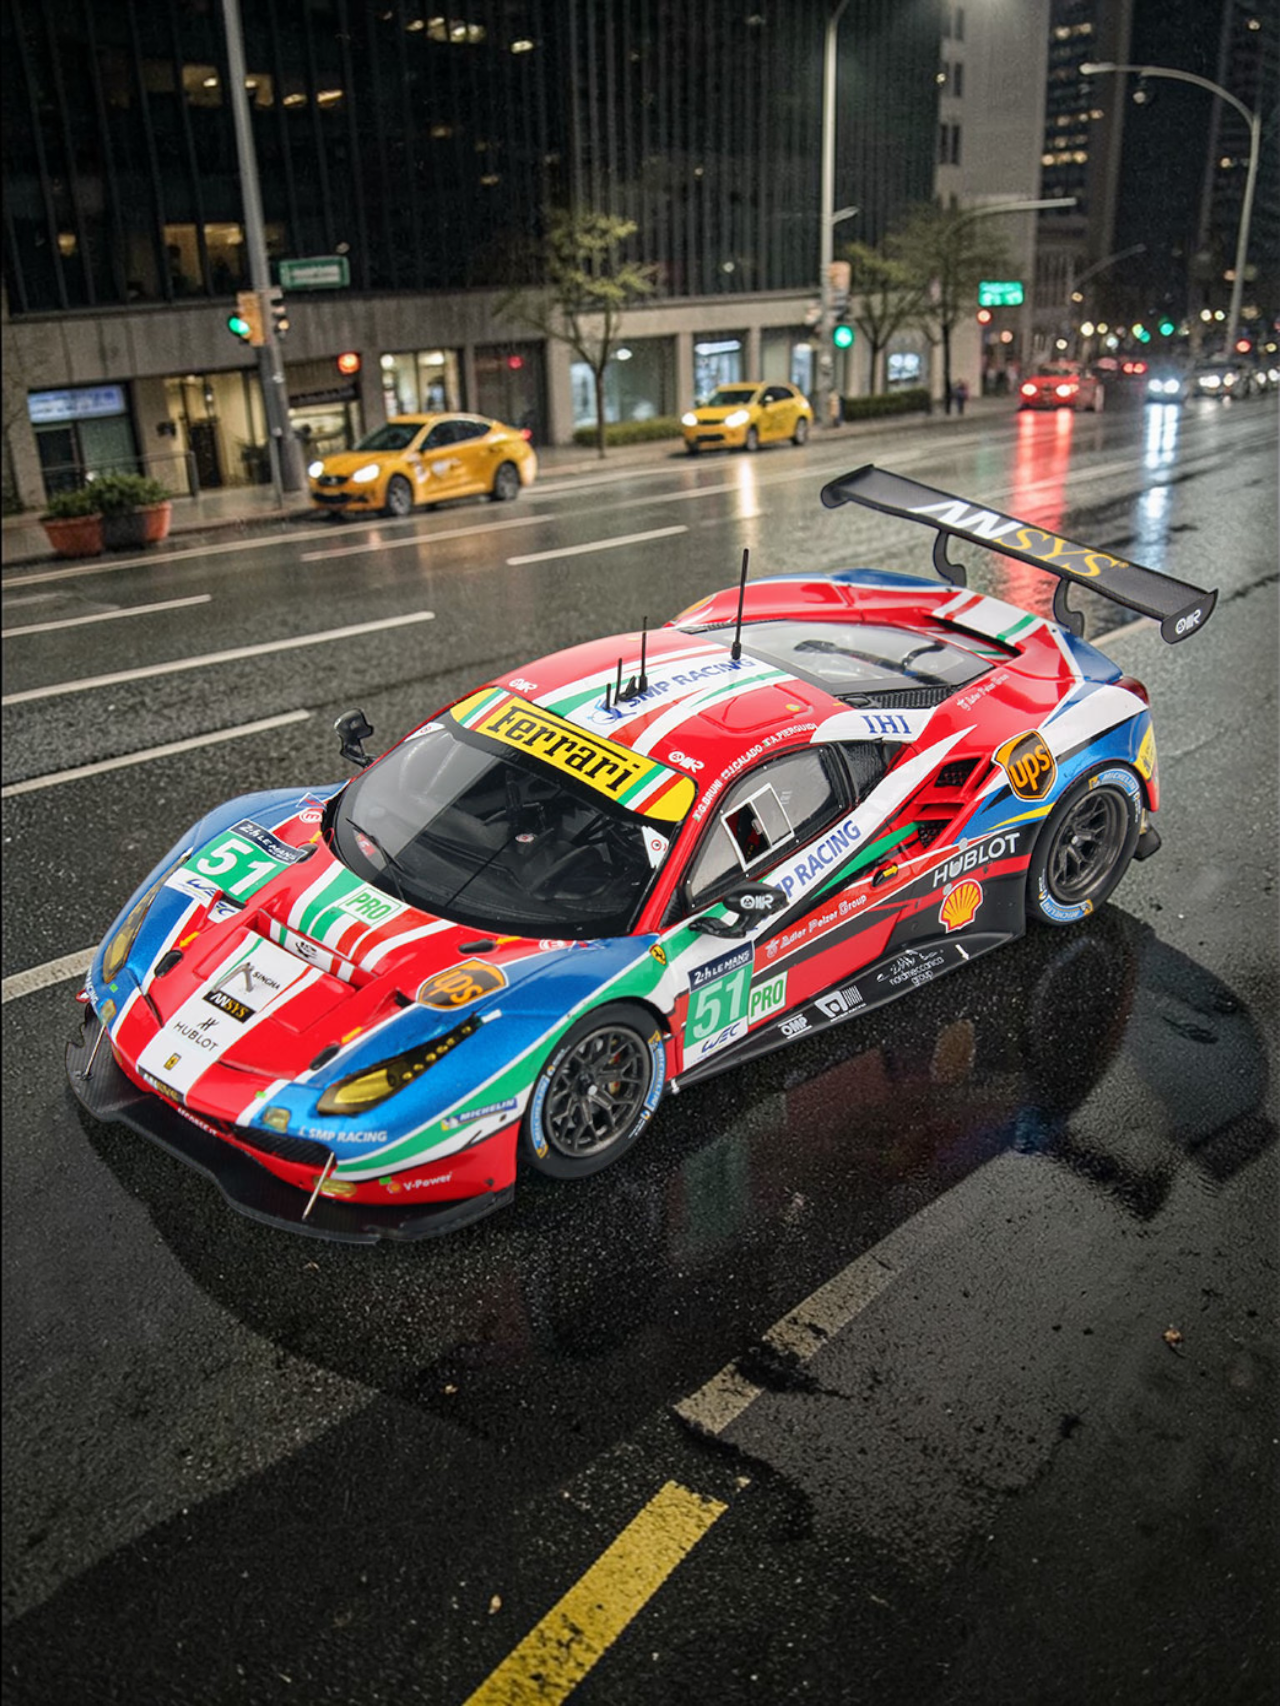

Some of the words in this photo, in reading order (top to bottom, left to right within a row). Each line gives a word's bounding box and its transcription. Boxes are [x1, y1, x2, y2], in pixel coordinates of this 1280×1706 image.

[671, 658, 756, 685] RACING
[861, 715, 912, 734] IHI
[486, 705, 641, 791] Ferrari
[1008, 744, 1051, 792] ups
[196, 838, 277, 896] 51
[794, 820, 861, 886] RACING
[932, 832, 1020, 888] HUBLOT
[345, 893, 392, 920] PRO
[838, 894, 867, 915] Group
[712, 964, 724, 976] LE
[428, 970, 483, 1003] ups
[751, 979, 784, 1018] PRO
[210, 993, 250, 1019] ANSYS
[693, 969, 746, 1039] 51
[174, 1021, 219, 1051] HUBLOT
[702, 1022, 740, 1053] WEC
[781, 1016, 808, 1036] OMP
[459, 1098, 516, 1122] MICHELIN
[309, 1128, 336, 1141] SMP
[336, 1130, 388, 1143] RACING
[403, 1171, 453, 1192] V-Power
